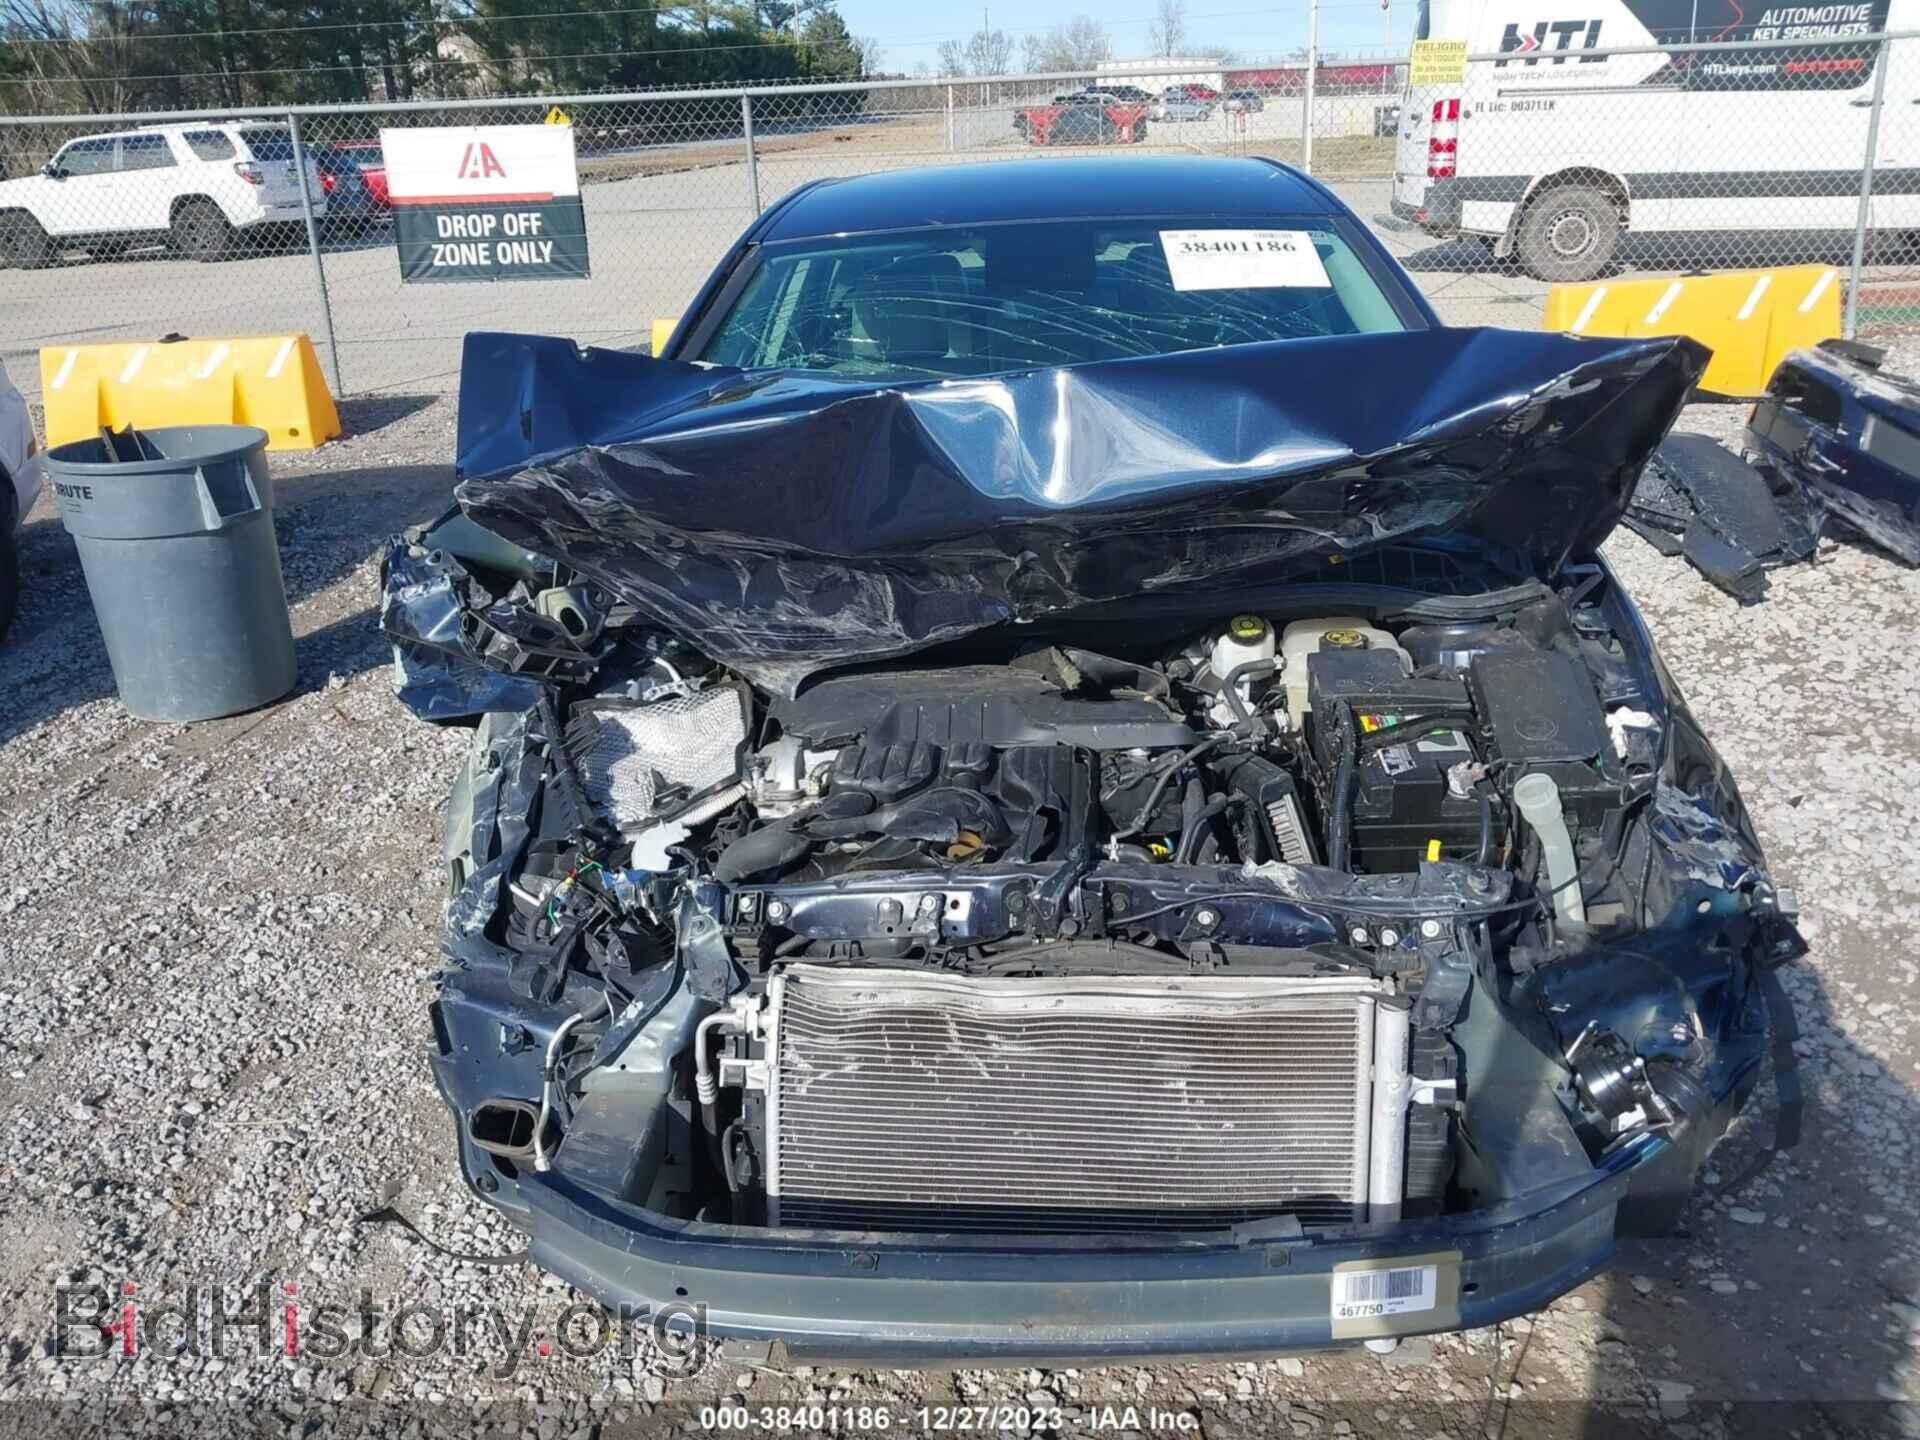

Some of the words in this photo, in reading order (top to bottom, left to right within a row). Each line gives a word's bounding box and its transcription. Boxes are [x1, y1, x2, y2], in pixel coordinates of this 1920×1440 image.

[1759, 2, 1873, 26] AUTOMOTIVE
[1753, 27, 1782, 41] KEY
[1782, 22, 1870, 40] SPECIALISTS
[1415, 42, 1466, 51] PELIGRO
[1494, 19, 1611, 67] HTL
[1703, 64, 1777, 76] HTLkeys.com
[436, 214, 496, 239] DROP
[503, 213, 542, 236] OFF
[431, 243, 491, 266] ZONE
[497, 240, 553, 264] ONLY
[1179, 241, 1297, 254] 38401186
[1338, 1303, 1383, 1317] 467750
